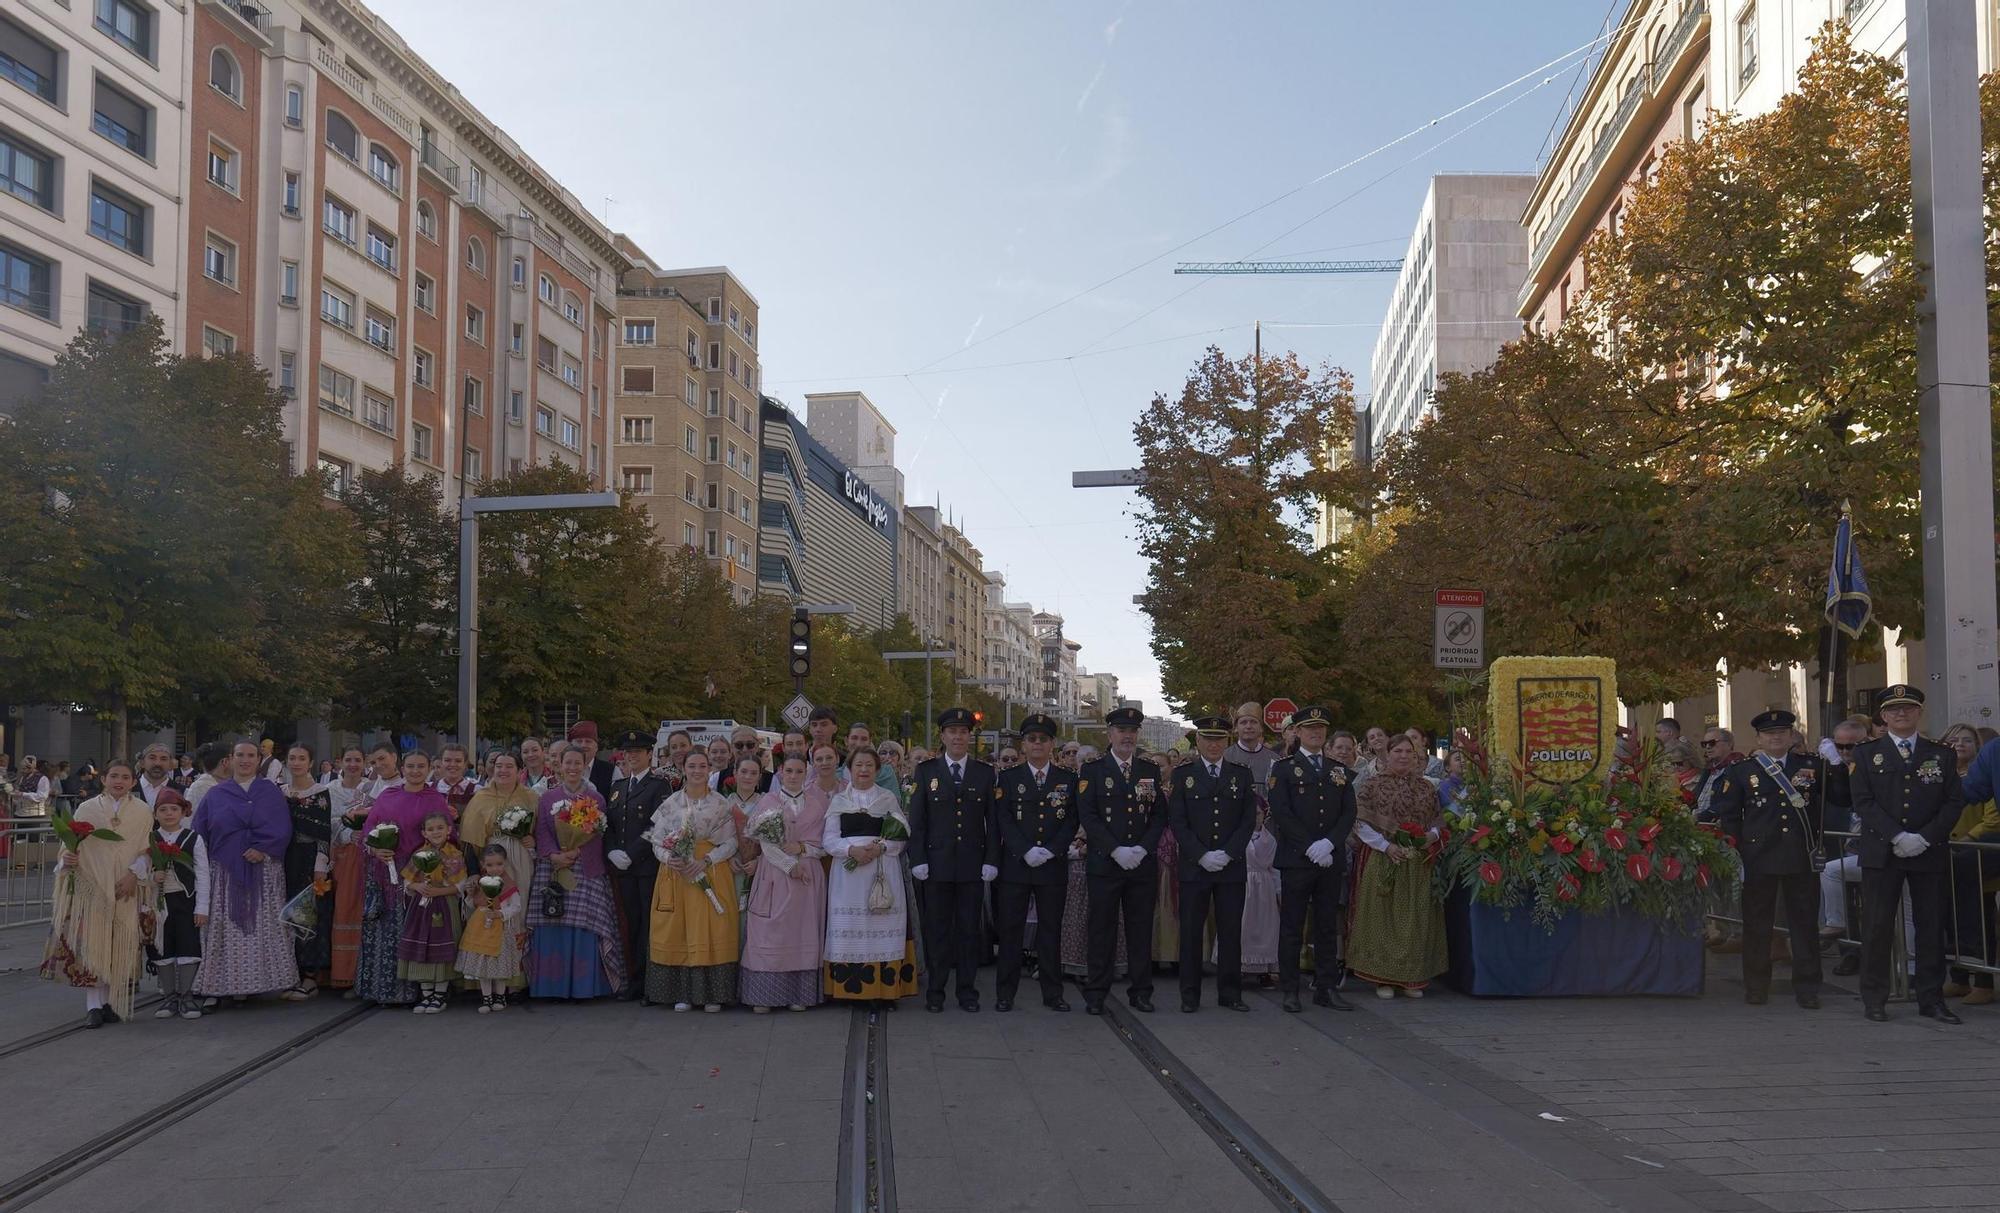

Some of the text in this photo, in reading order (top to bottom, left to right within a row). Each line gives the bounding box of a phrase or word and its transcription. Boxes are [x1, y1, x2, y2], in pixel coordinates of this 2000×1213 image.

[845, 470, 853, 498] El
[853, 479, 868, 510] Corte
[1440, 647, 1479, 655] PRIORIDAD
[1440, 656, 1477, 664] PEATONAL
[792, 706, 809, 719] 30
[1530, 750, 1592, 762] POLICIA
